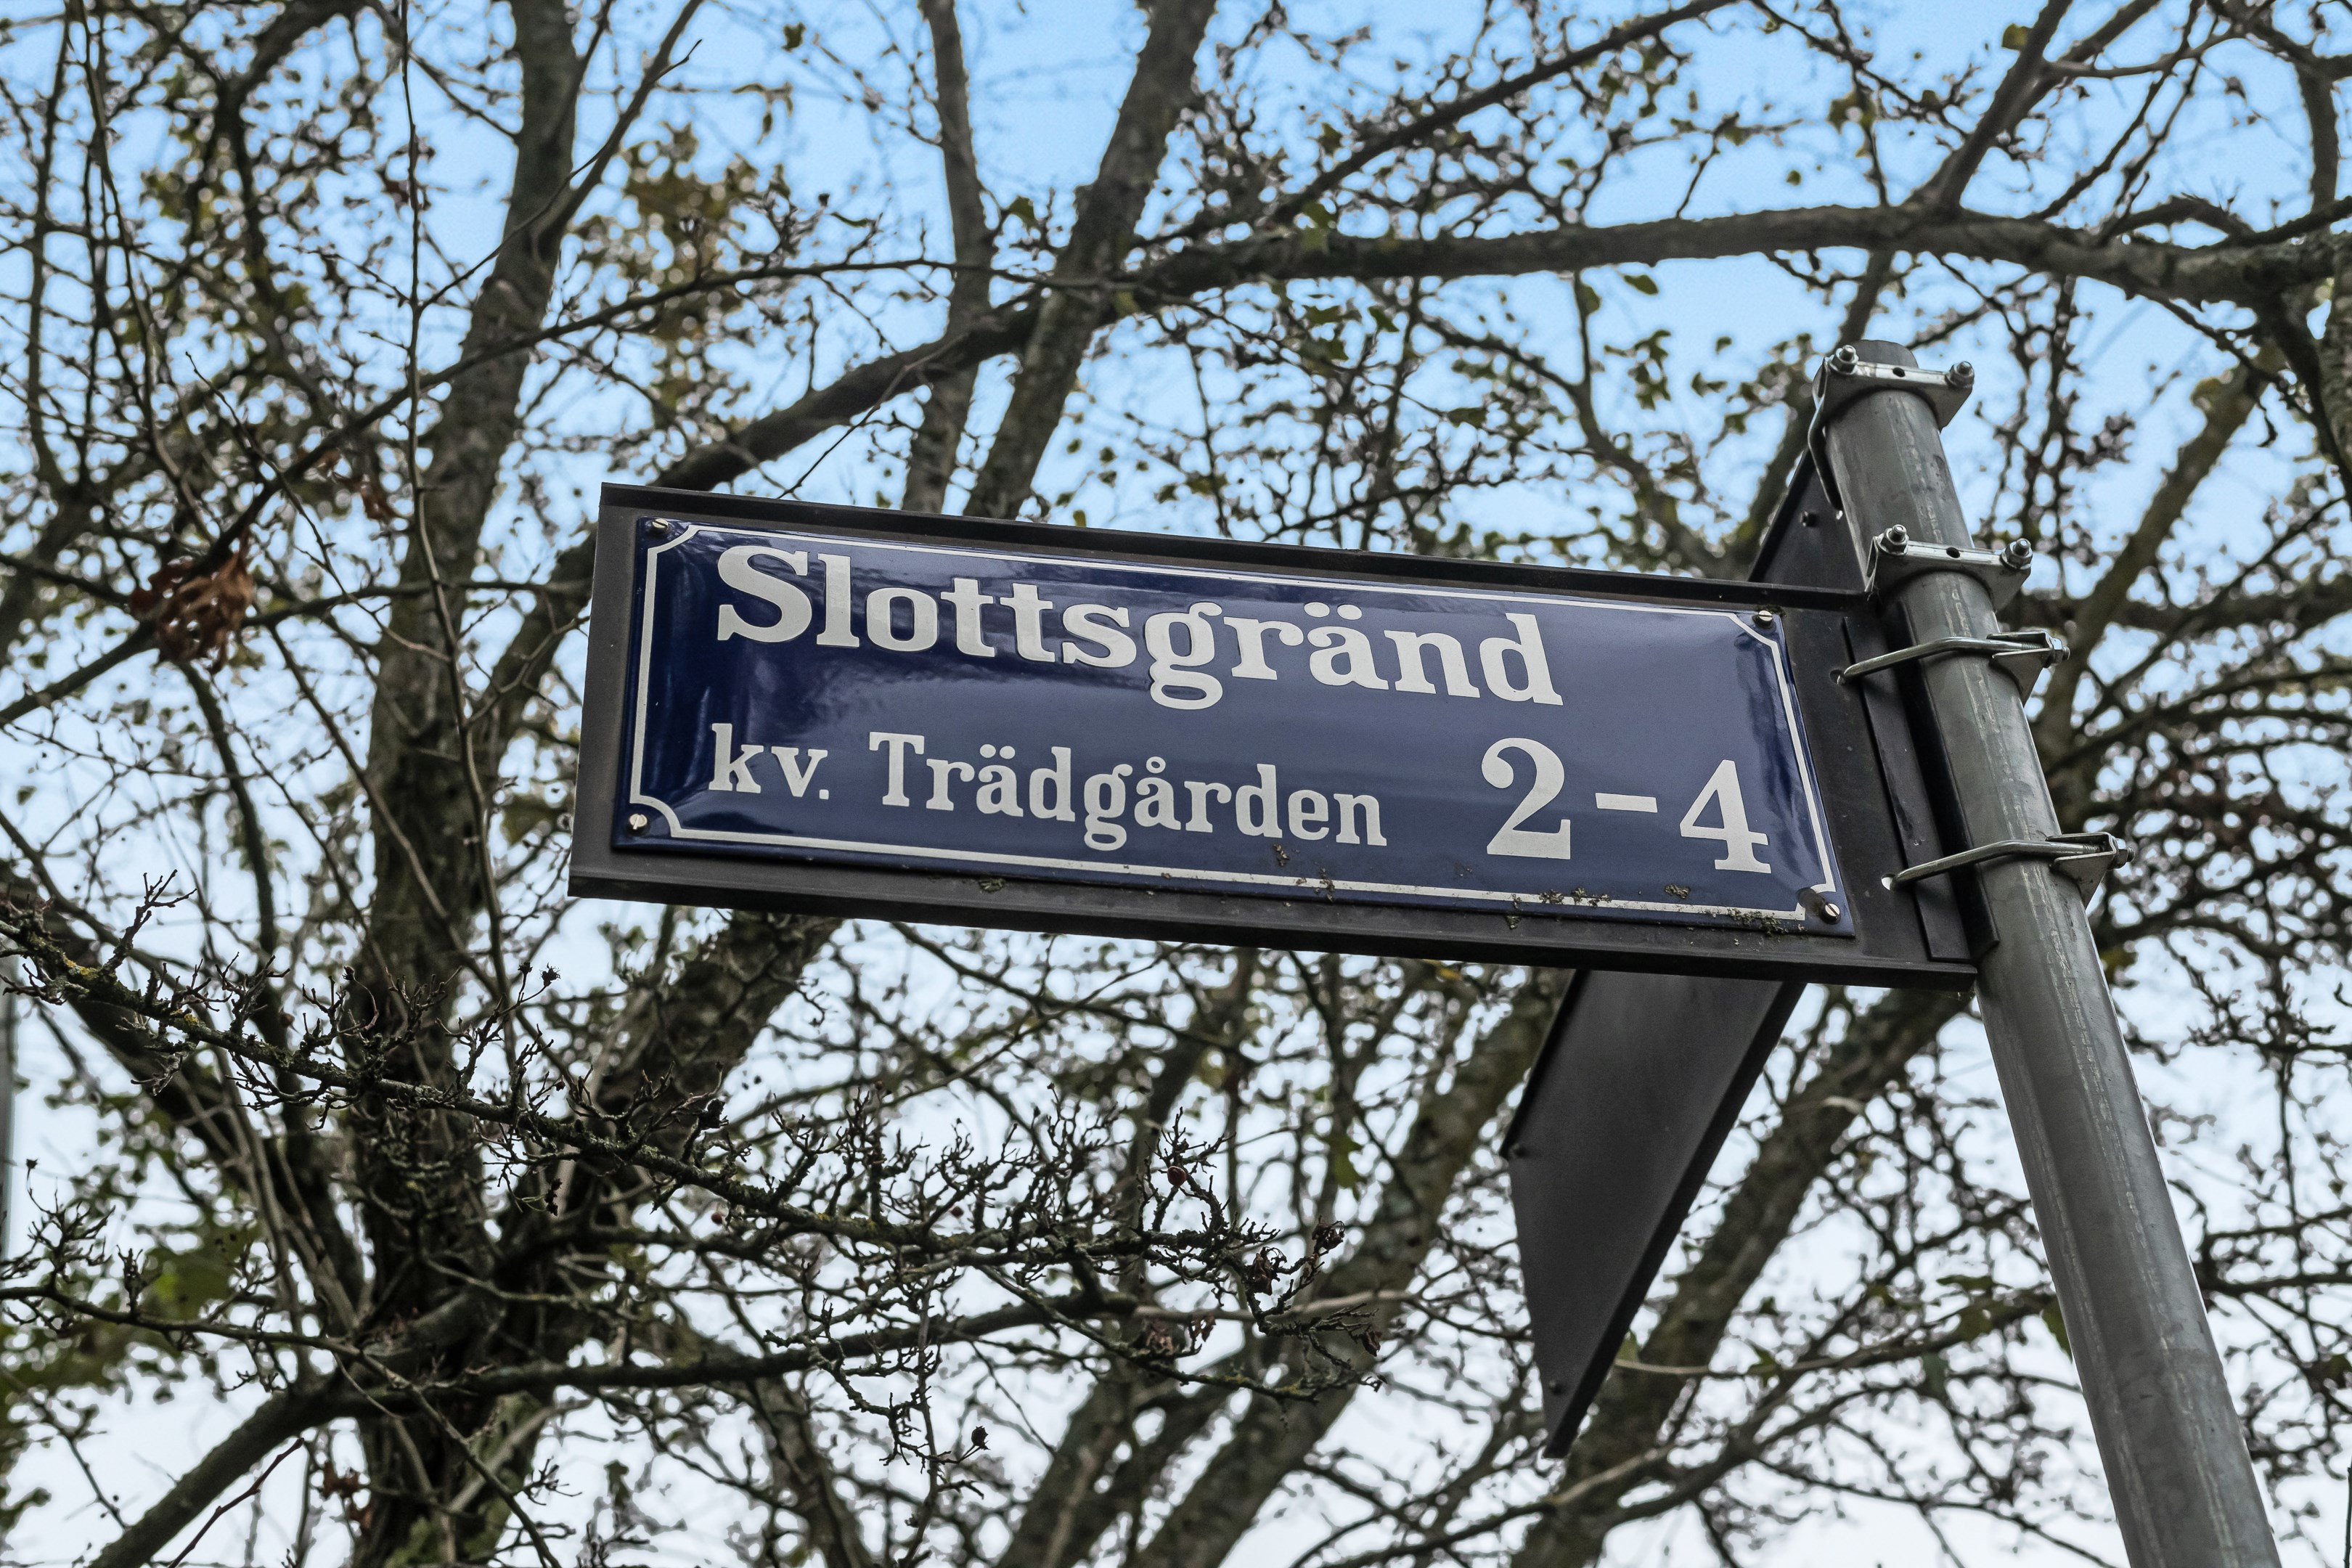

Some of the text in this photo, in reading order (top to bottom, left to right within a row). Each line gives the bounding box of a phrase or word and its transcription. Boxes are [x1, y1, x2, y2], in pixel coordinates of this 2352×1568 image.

[716, 544, 1564, 711] Slottsgränd
[707, 722, 830, 801] kv.
[868, 730, 1388, 852] Trädgården
